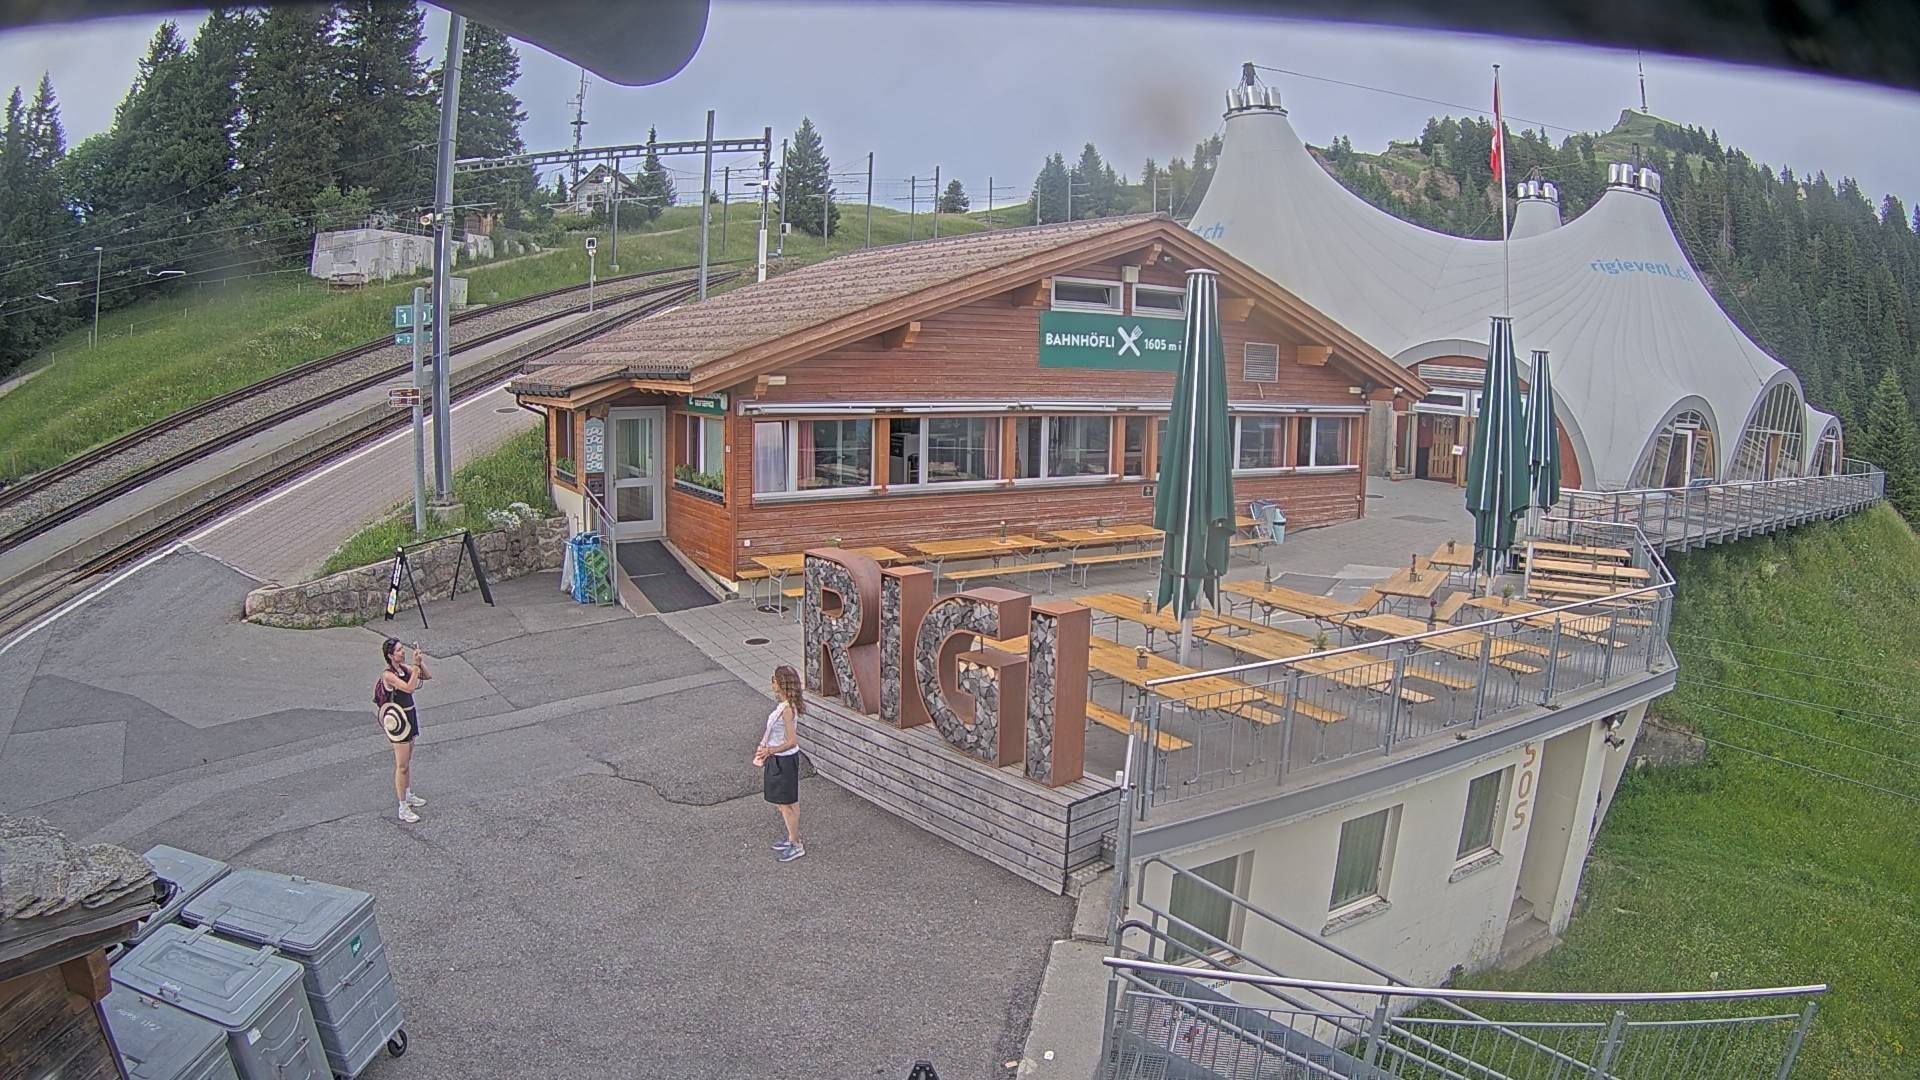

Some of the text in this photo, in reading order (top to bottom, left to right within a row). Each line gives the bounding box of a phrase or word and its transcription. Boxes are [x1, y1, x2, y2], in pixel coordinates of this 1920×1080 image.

[1045, 331, 1115, 348] BAHNHÖFLI
[1144, 338, 1167, 350] 1605
[803, 549, 1091, 788] RIGI
[1511, 742, 1537, 832] SOS
